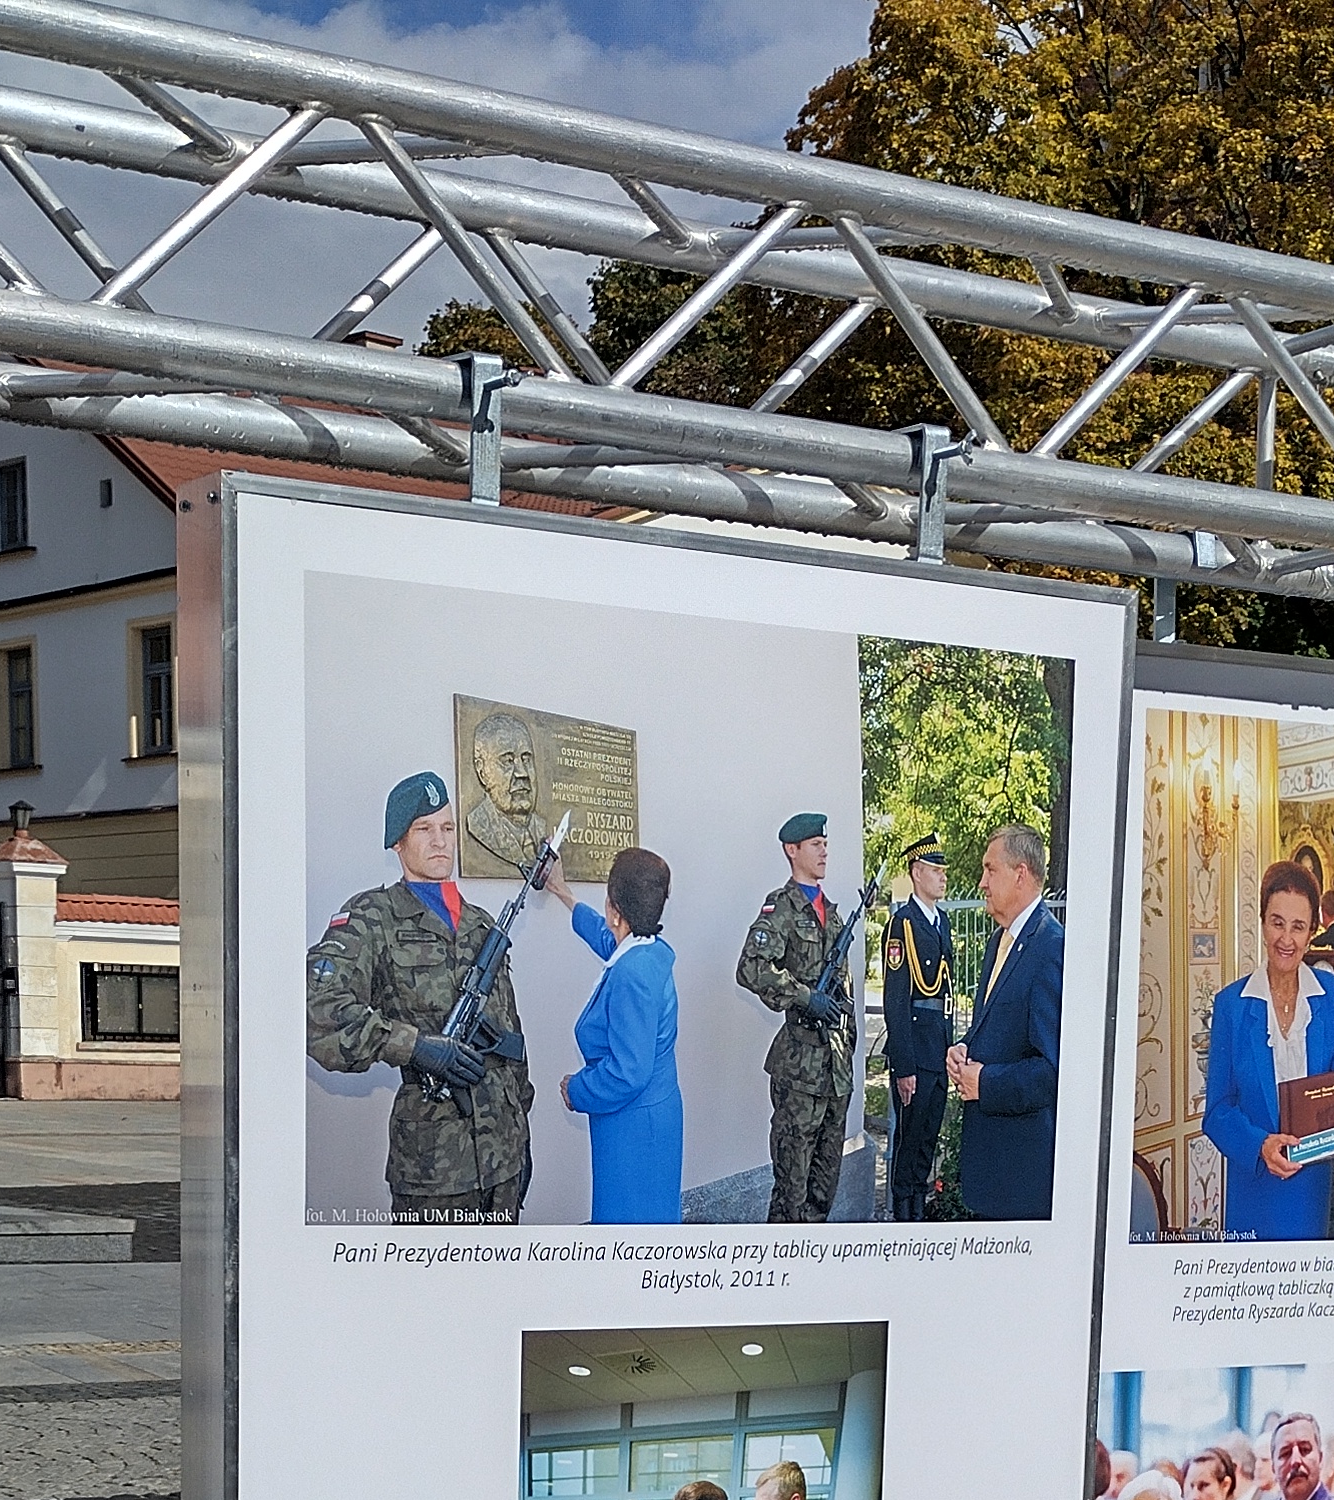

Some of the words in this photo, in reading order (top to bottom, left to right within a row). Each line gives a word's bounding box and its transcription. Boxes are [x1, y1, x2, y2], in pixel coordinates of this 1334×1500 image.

[586, 812, 634, 830] RYSZARD
[305, 1209, 327, 1223] fot.
[332, 1209, 350, 1223] M.
[423, 1209, 449, 1223] UM
[1145, 1231, 1157, 1242] M.
[1201, 1231, 1218, 1241] UM
[333, 1243, 378, 1263] Pani
[384, 1242, 522, 1268] Prezydentowa
[527, 1241, 606, 1262] Karolina
[612, 1240, 727, 1261] Kaczorowska
[731, 1245, 769, 1265] przy
[773, 1240, 829, 1264] tablicy
[832, 1238, 958, 1263] upamiętniającej
[961, 1236, 1032, 1256] Małżonka,
[1174, 1260, 1203, 1276] Pani
[1207, 1258, 1297, 1279] Prezydentowa
[1300, 1261, 1311, 1272] w
[642, 1269, 724, 1294] Białystok,
[730, 1270, 775, 1288] 2011
[781, 1273, 790, 1286] r.
[1183, 1287, 1192, 1299] z
[1193, 1281, 1275, 1303] pamiątkową
[1278, 1279, 1334, 1299] tabliczką
[1173, 1305, 1245, 1326] Prezydenta
[1248, 1302, 1305, 1324] Ryszarda
